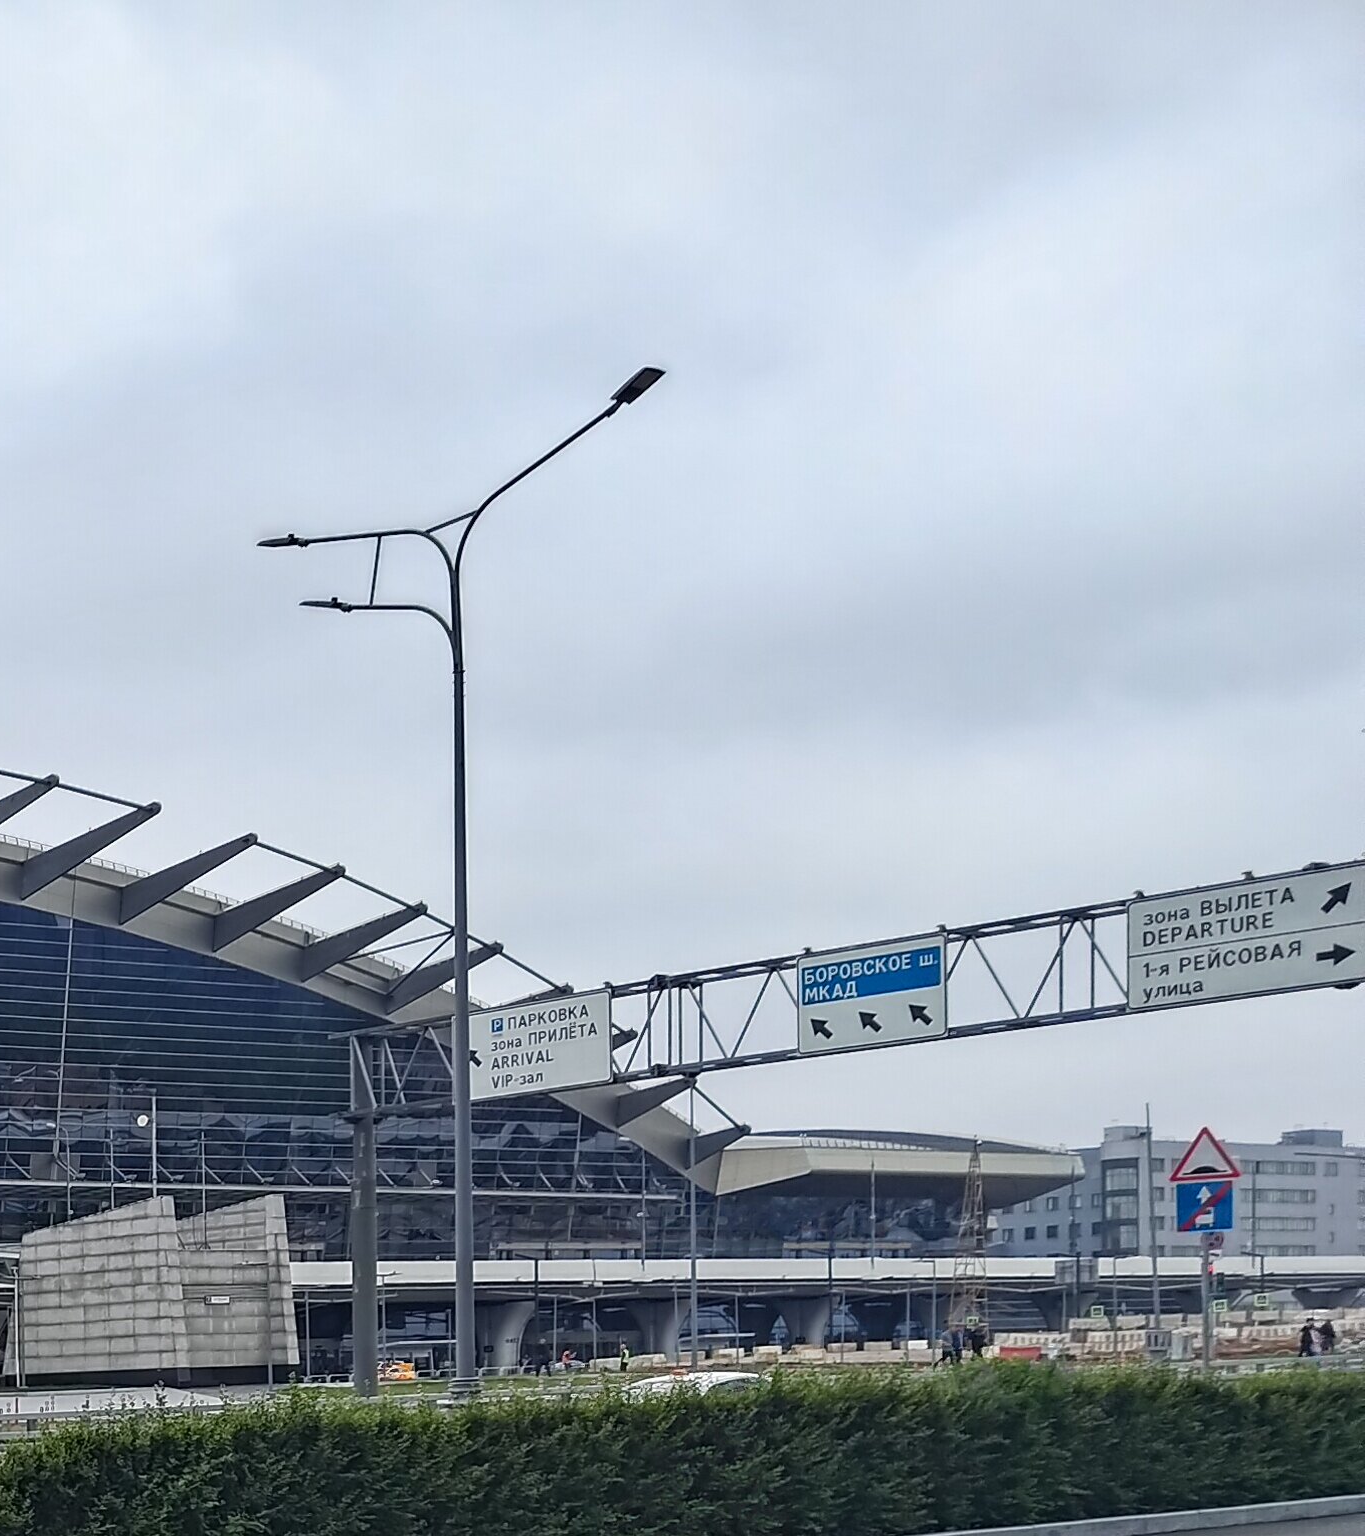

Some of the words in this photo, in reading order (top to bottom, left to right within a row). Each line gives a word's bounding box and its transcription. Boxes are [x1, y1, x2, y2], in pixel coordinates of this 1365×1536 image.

[1143, 907, 1190, 926] зона
[1200, 887, 1295, 917] ВЫЛЕТА
[1143, 912, 1275, 947] DEPARTURE
[804, 953, 912, 985] БОРОВСКОЕ
[919, 953, 939, 967] ш.
[1143, 963, 1169, 978] 1-я
[1179, 940, 1302, 973] РЕЙСОВАЯ
[804, 981, 858, 1003] МКАД
[1142, 980, 1204, 1004] улица
[508, 1004, 589, 1030] ПАРКОВКА
[491, 1038, 522, 1052] зона
[528, 1022, 598, 1046] ПРИЛЁТА
[491, 1049, 554, 1071] ARRIVAL
[491, 1072, 544, 1089] VIP-зал
